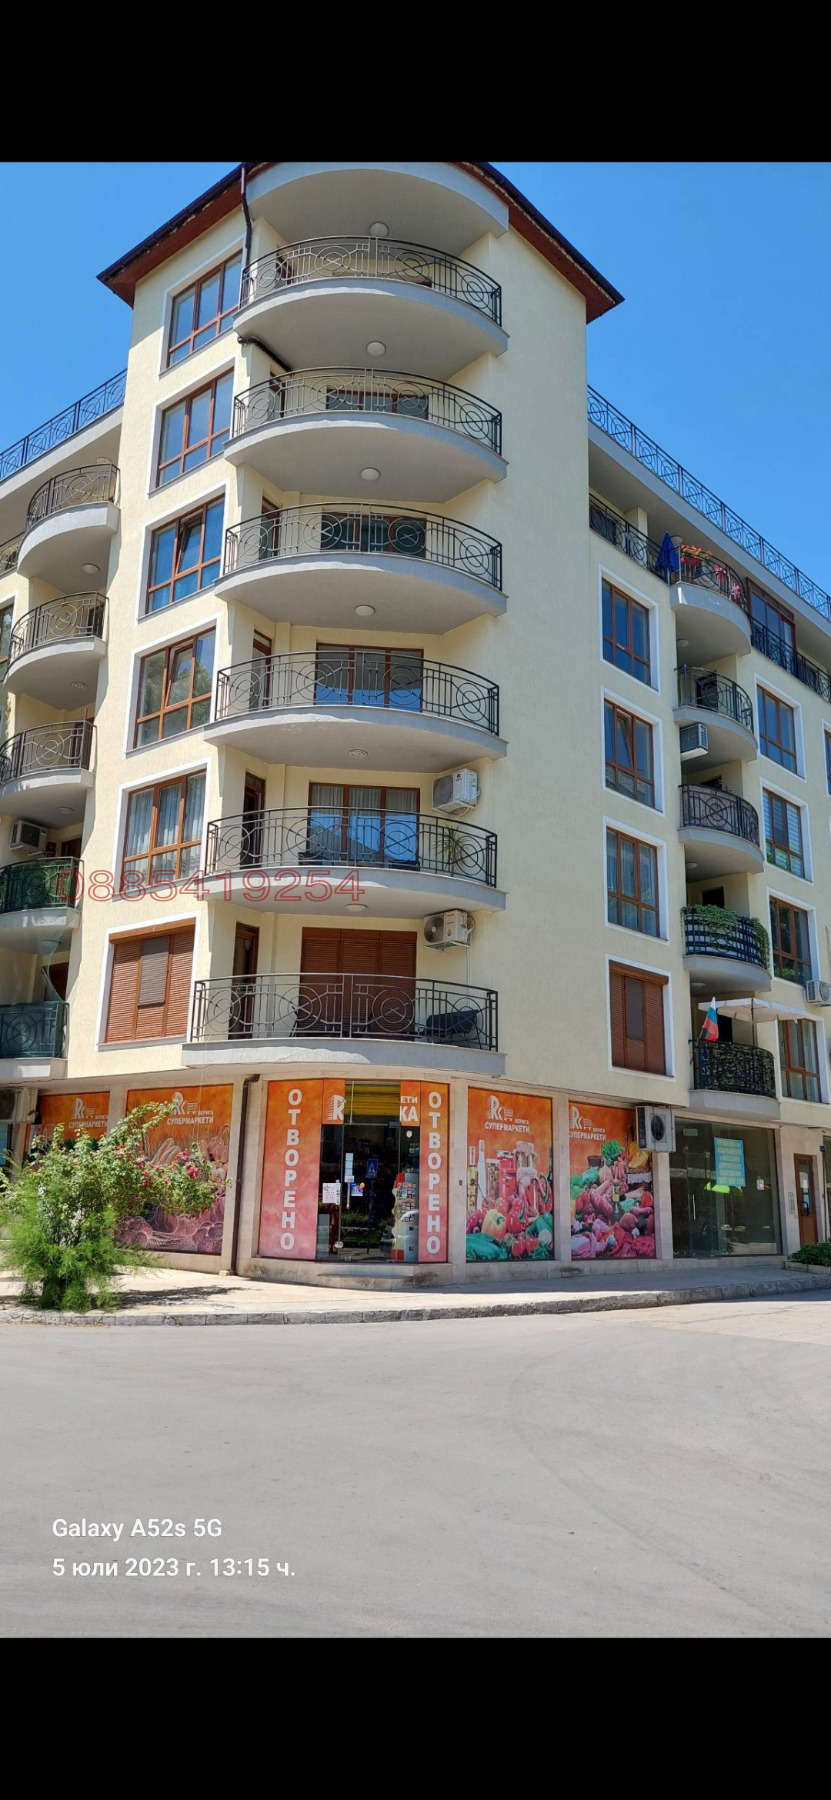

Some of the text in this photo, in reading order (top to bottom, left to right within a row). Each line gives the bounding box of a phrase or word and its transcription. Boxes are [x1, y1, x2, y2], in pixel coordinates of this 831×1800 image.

[167, 1116, 213, 1125] СУПЕРМАРКЕТИ
[485, 1121, 529, 1132] СУПЕРМАРКЕТИ
[280, 1089, 302, 1250] ОТВОРЕНО
[427, 1092, 442, 1253] ОТВОРЕНО
